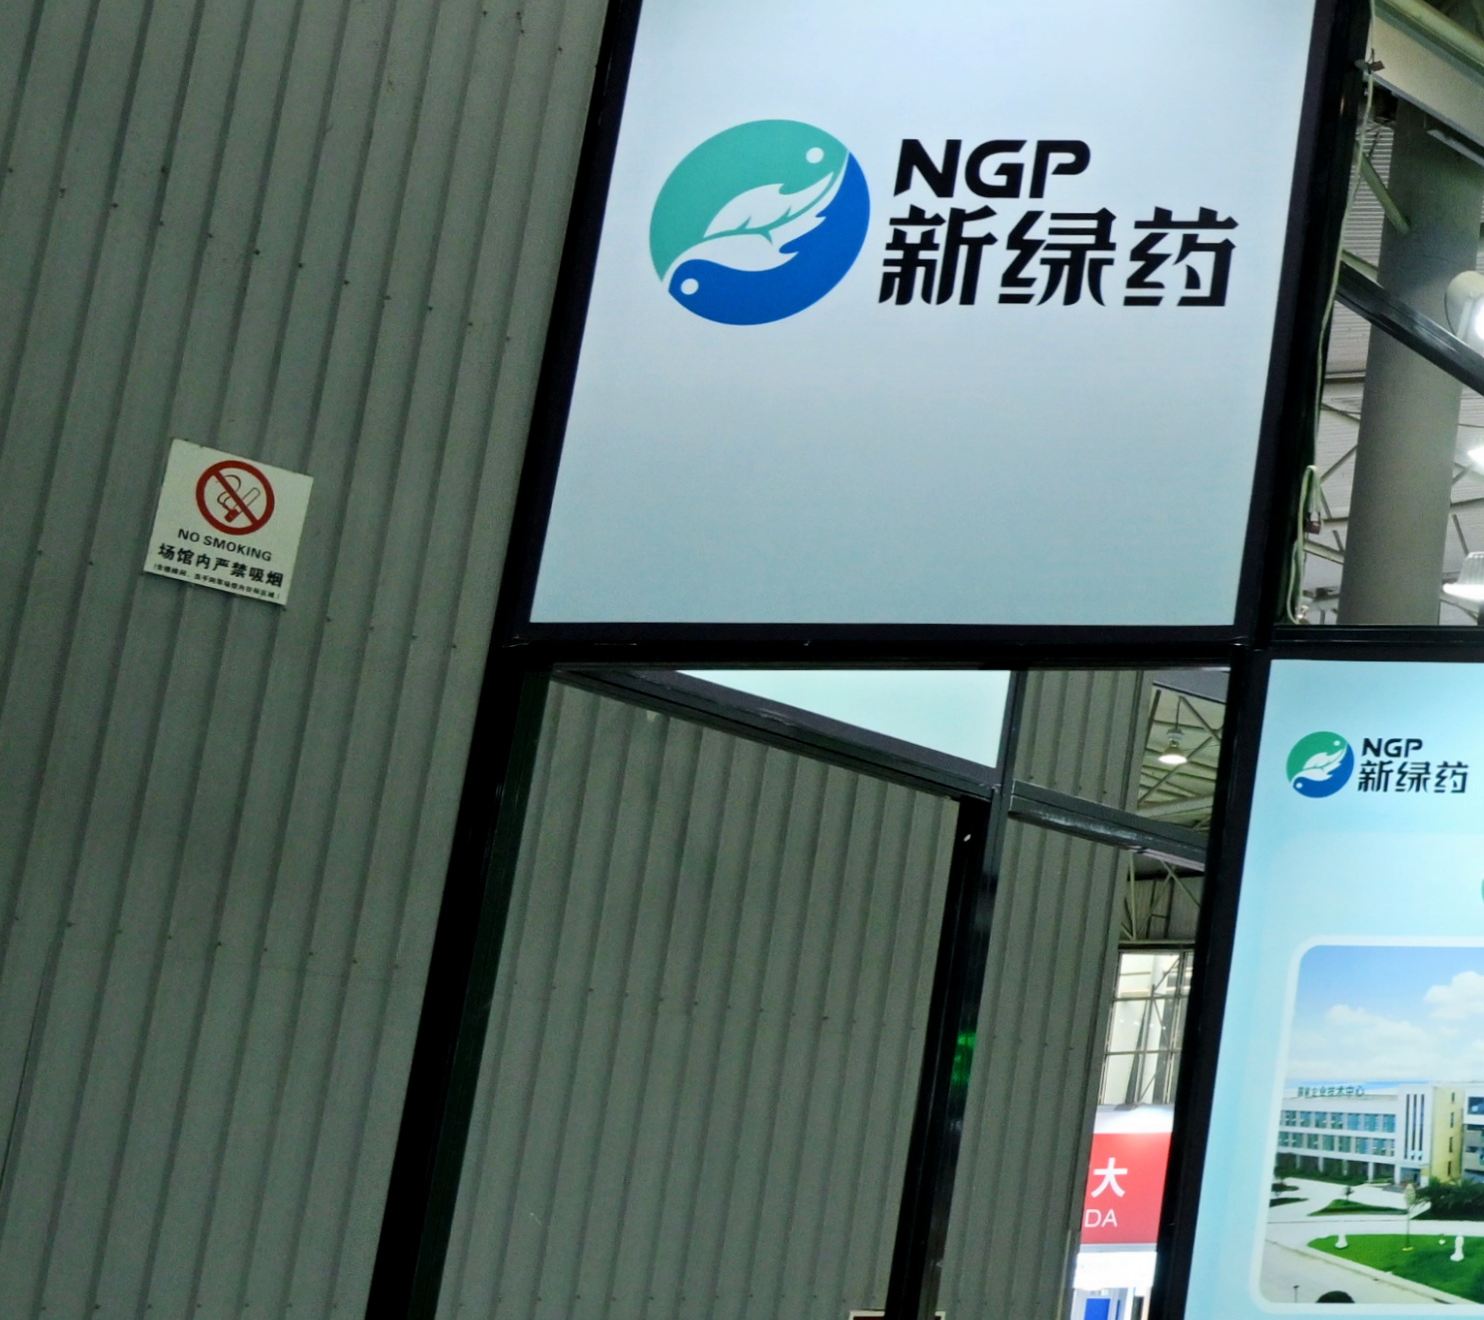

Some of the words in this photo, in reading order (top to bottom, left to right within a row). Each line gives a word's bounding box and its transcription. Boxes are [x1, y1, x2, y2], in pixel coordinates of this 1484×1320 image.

[894, 139, 1091, 198] NGP
[878, 205, 1239, 307] 新绿药
[158, 542, 285, 588] 场馆内严禁吸烟
[177, 528, 200, 543] NO
[203, 535, 272, 562] SMOKING
[1361, 737, 1423, 758] NGP
[1357, 760, 1469, 795] 新绿药
